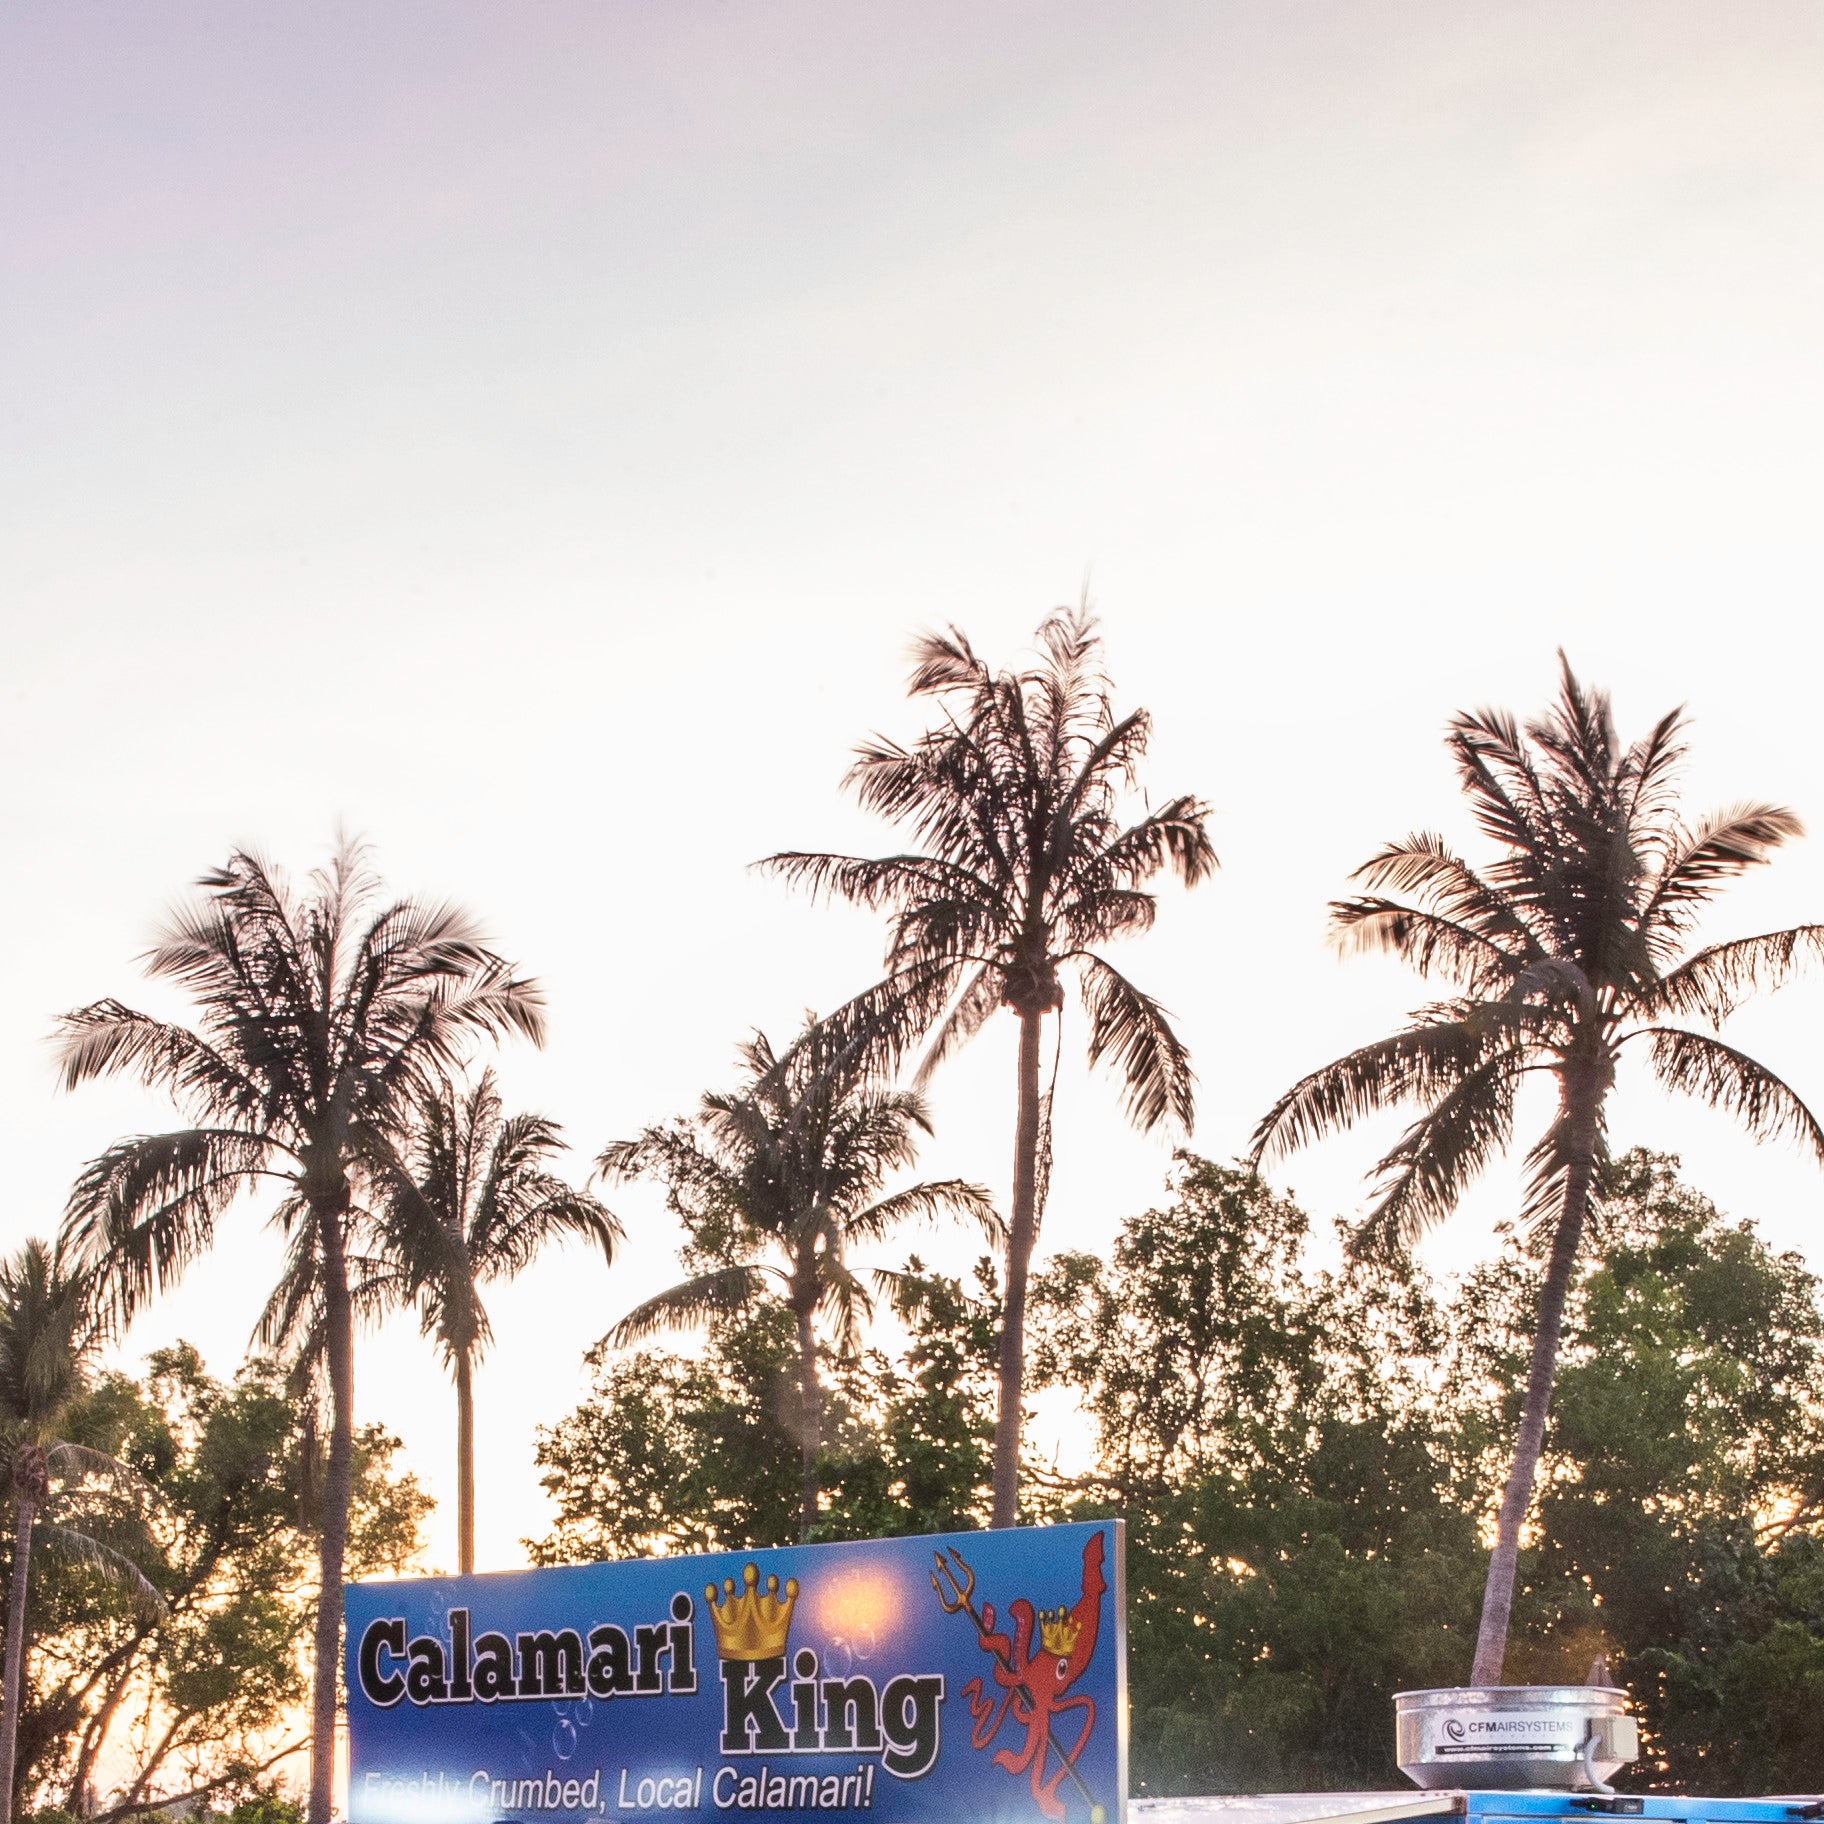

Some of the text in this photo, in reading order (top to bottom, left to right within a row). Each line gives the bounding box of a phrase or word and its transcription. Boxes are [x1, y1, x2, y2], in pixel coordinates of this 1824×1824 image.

[358, 1591, 945, 1778] Calamari King
[468, 1769, 605, 1814] Crumbed,
[618, 1767, 702, 1808] Local
[713, 1764, 875, 1809] Calamari!
